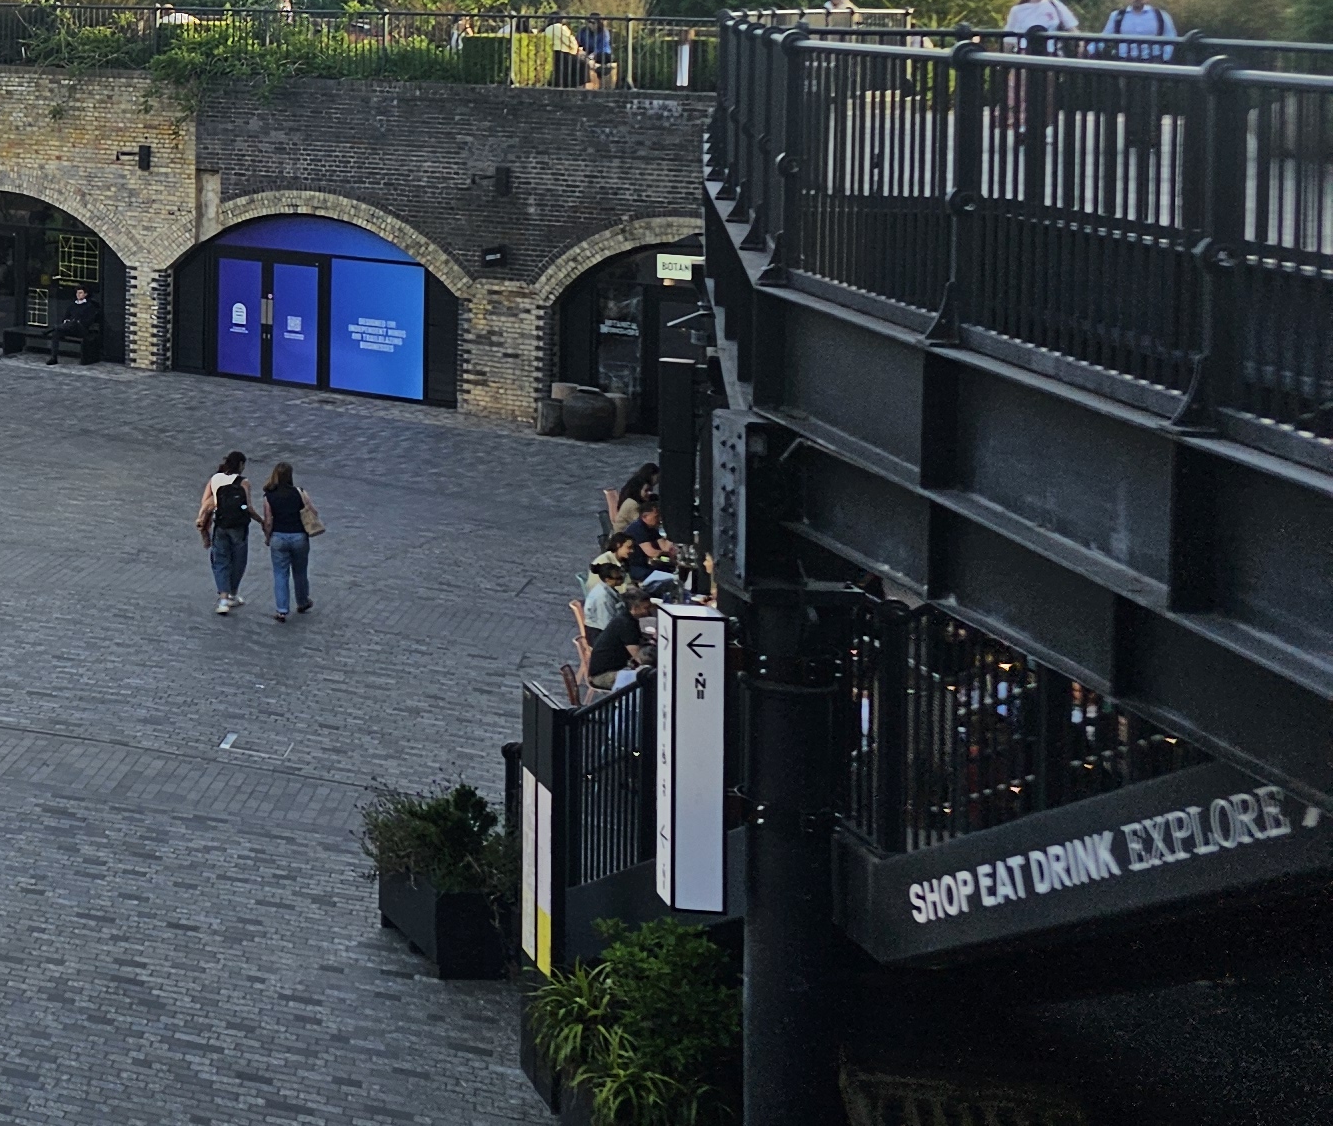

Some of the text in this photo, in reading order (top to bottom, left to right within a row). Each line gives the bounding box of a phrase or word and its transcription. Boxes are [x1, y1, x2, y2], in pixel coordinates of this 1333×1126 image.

[909, 785, 1292, 924] SHOP EAT DRINK EXPLORE
